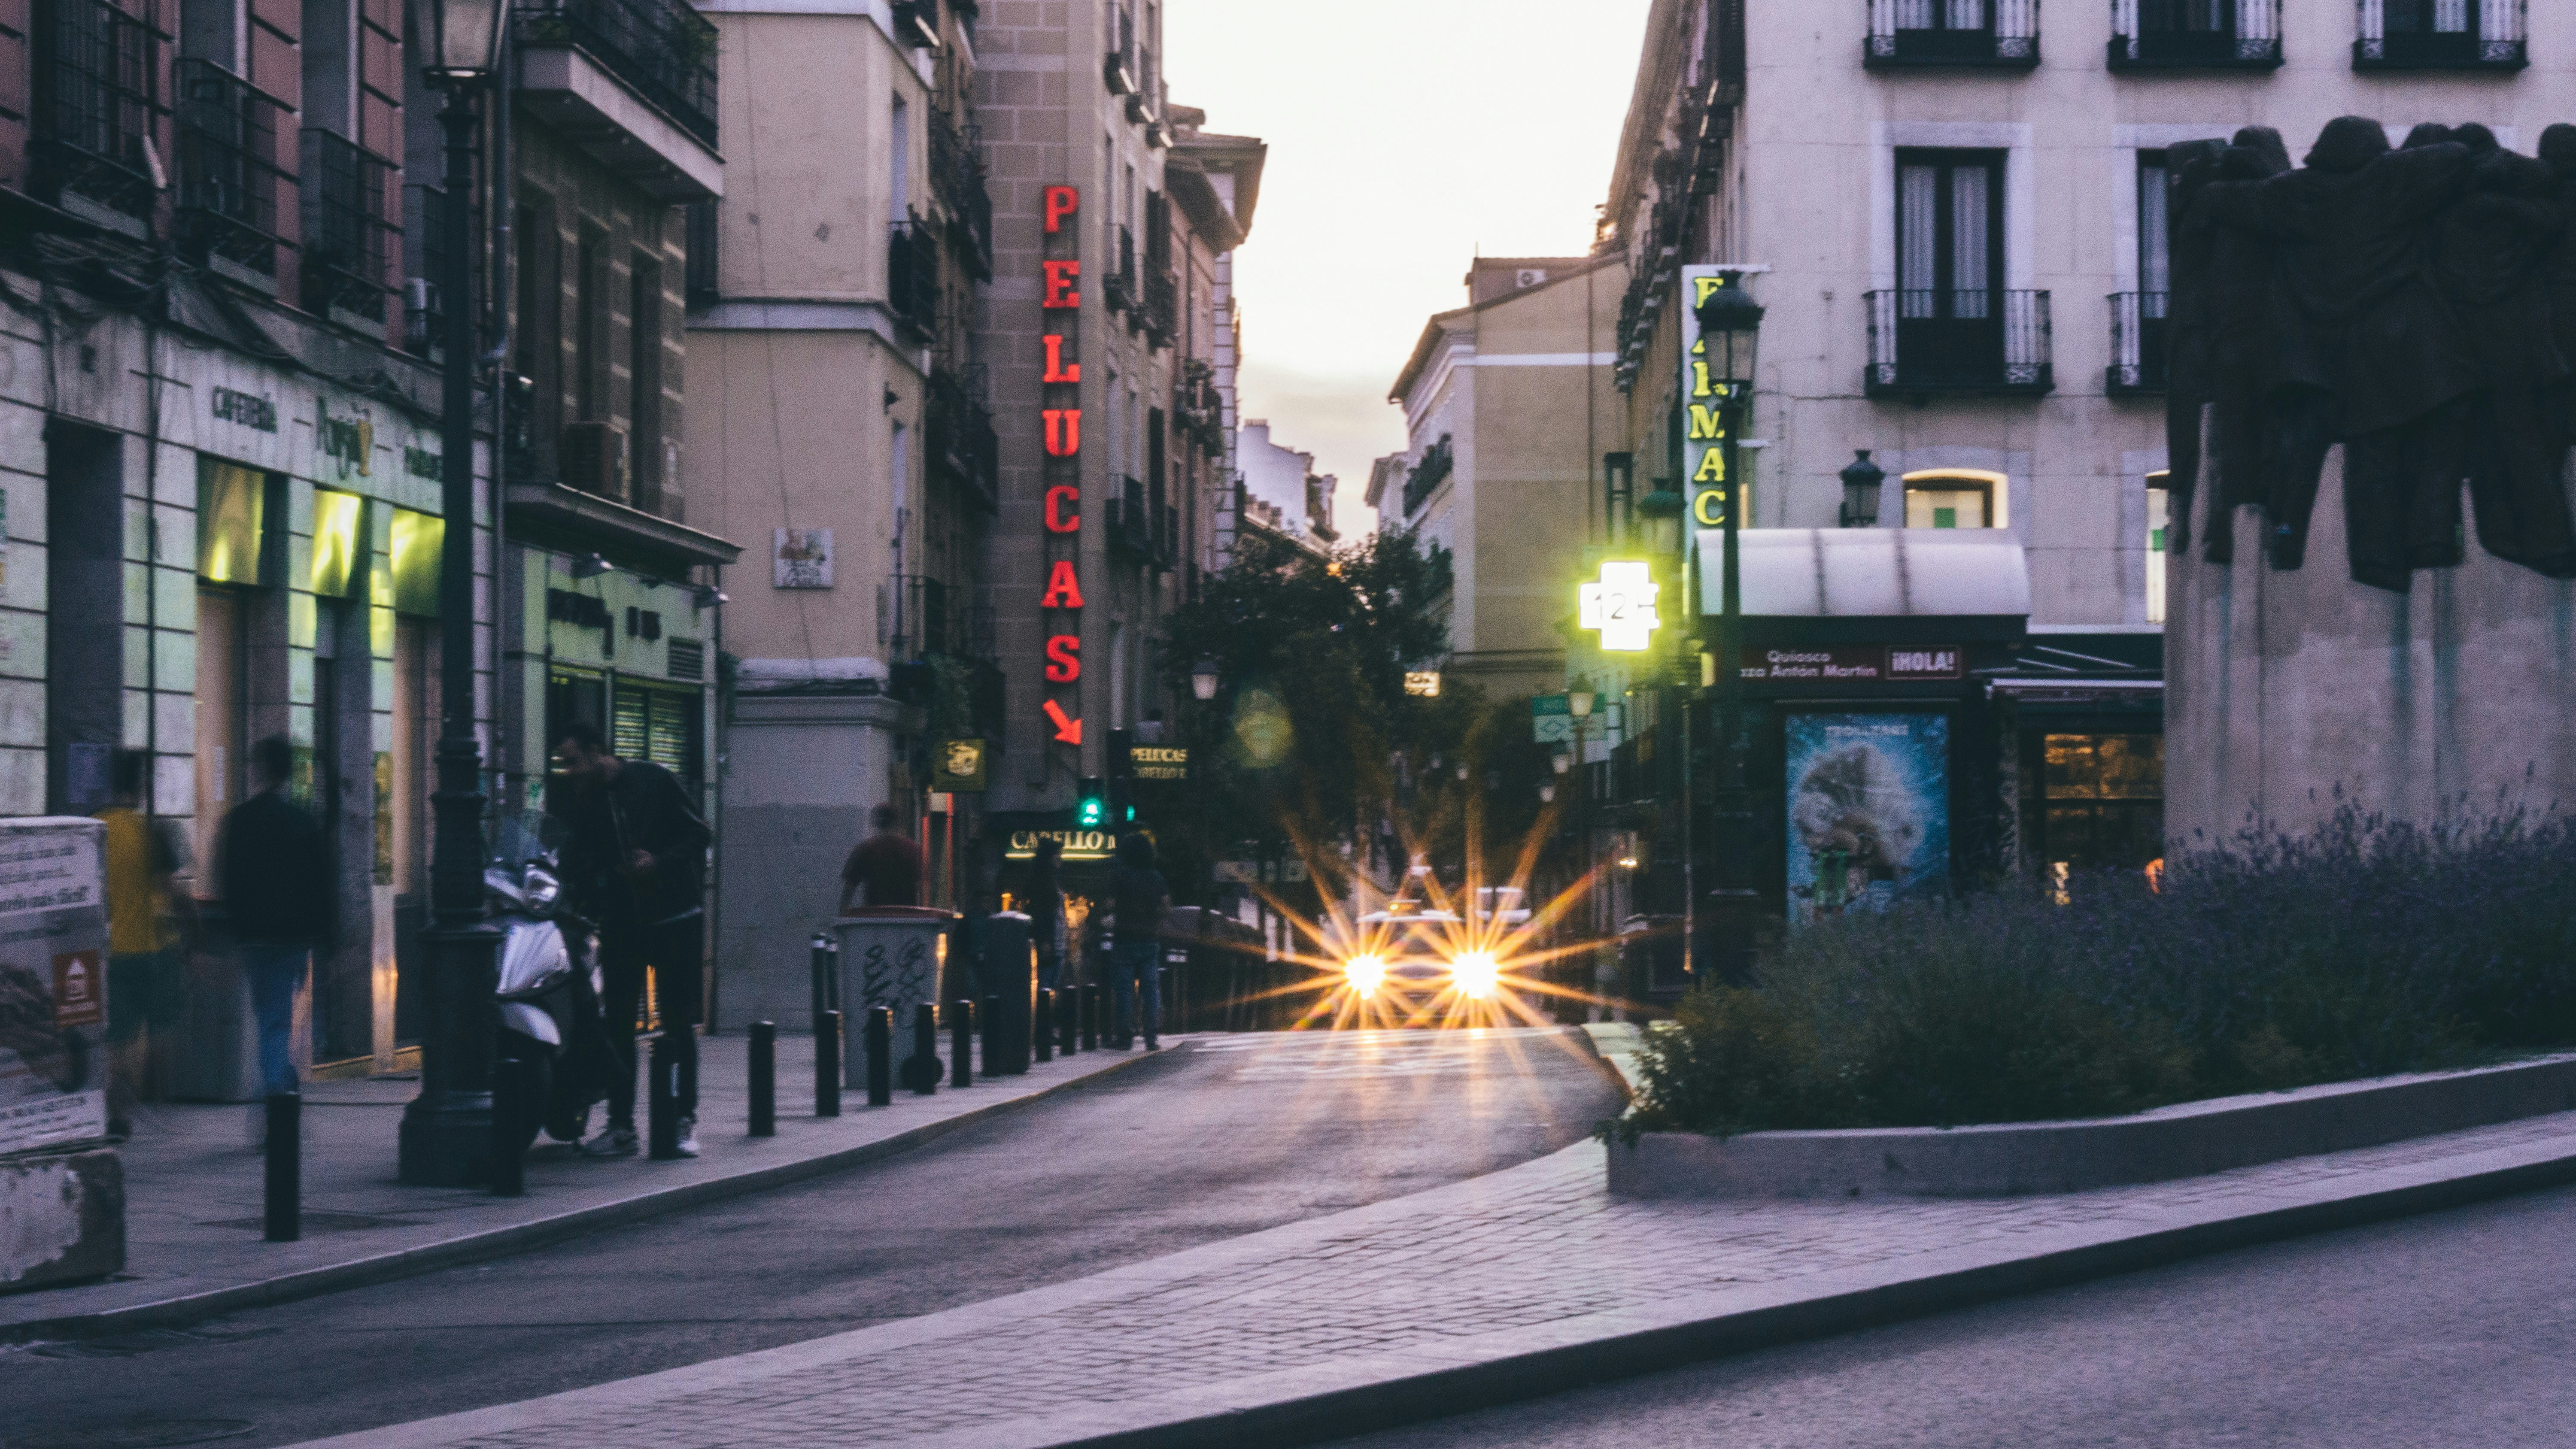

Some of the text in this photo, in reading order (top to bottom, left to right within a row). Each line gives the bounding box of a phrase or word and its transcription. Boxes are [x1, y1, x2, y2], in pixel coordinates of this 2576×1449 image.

[1041, 186, 1084, 682] PELUCAS
[1767, 650, 1832, 663] Quiosco
[1892, 652, 1954, 671] ¡HOLA!
[1770, 664, 1819, 677] Antón
